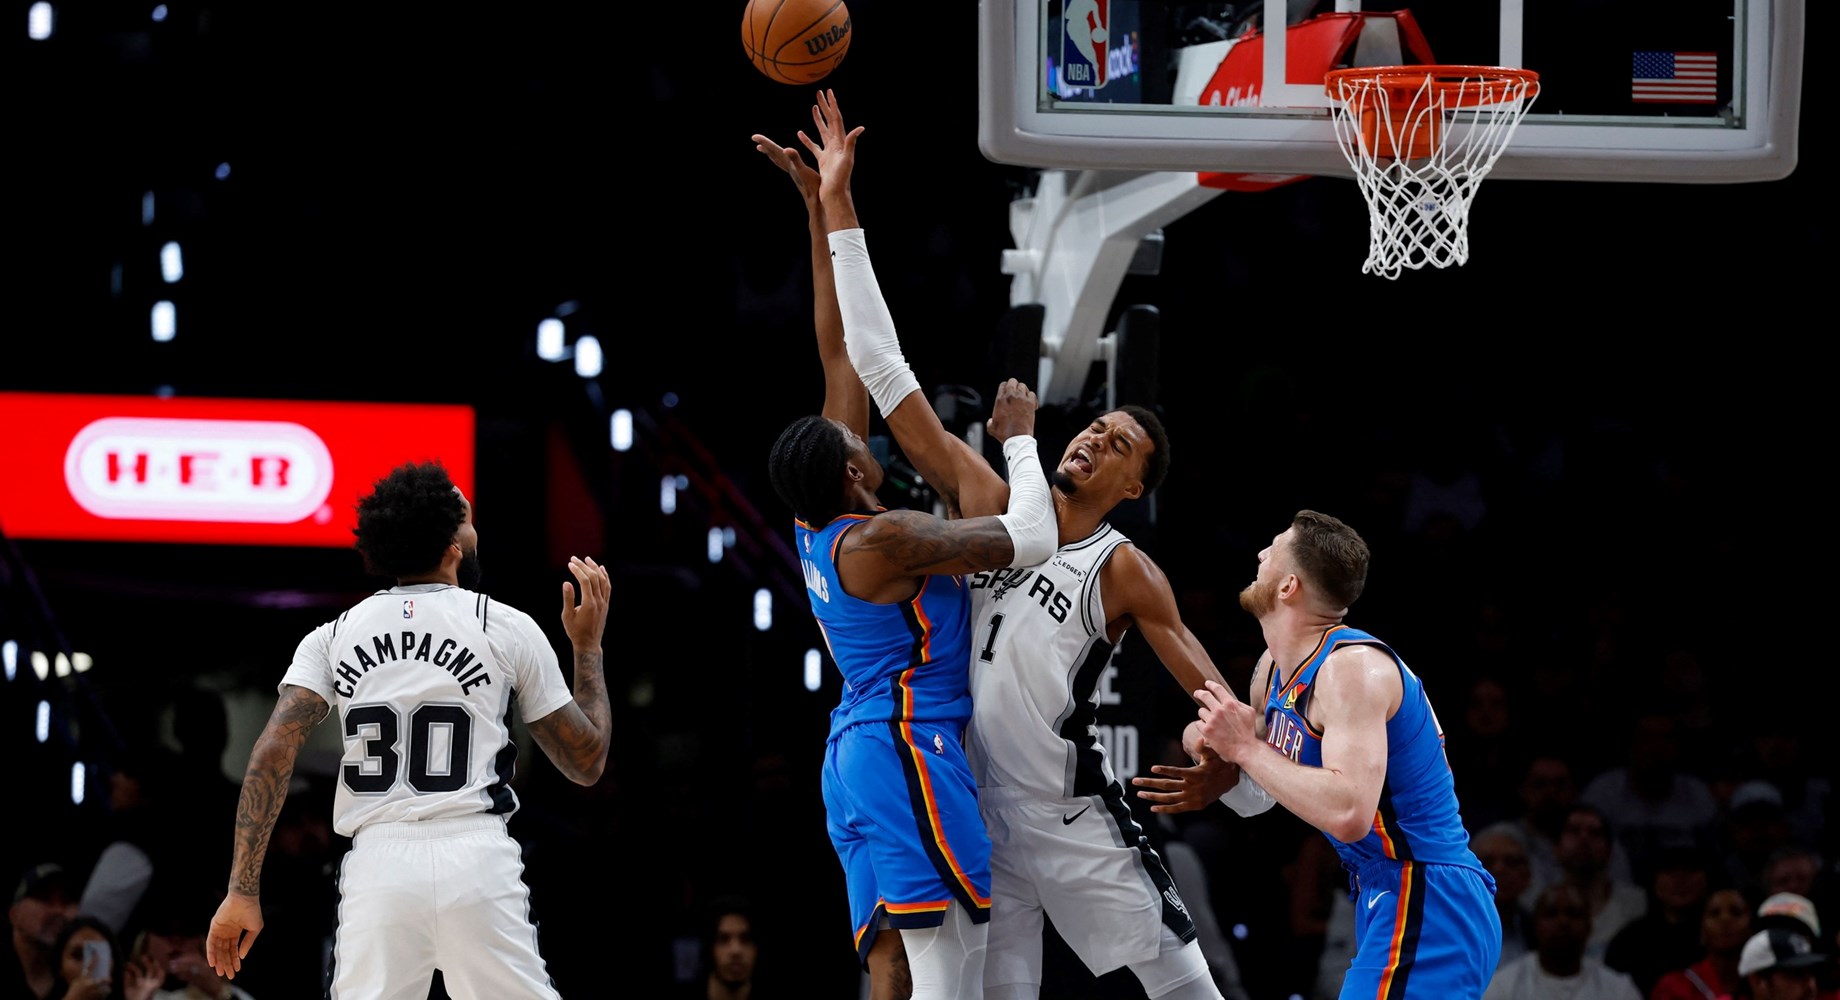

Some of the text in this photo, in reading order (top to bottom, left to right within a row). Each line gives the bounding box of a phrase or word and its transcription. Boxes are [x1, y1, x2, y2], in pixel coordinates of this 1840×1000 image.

[805, 16, 851, 56] Wilso
[1067, 63, 1091, 81] NBA
[970, 567, 1072, 624] SPURS
[1058, 560, 1082, 578] LEDGER
[334, 631, 492, 699] CHAMPAGNIE
[979, 612, 1006, 665] 1
[341, 701, 476, 797] 30
[1267, 709, 1304, 765] NDER
